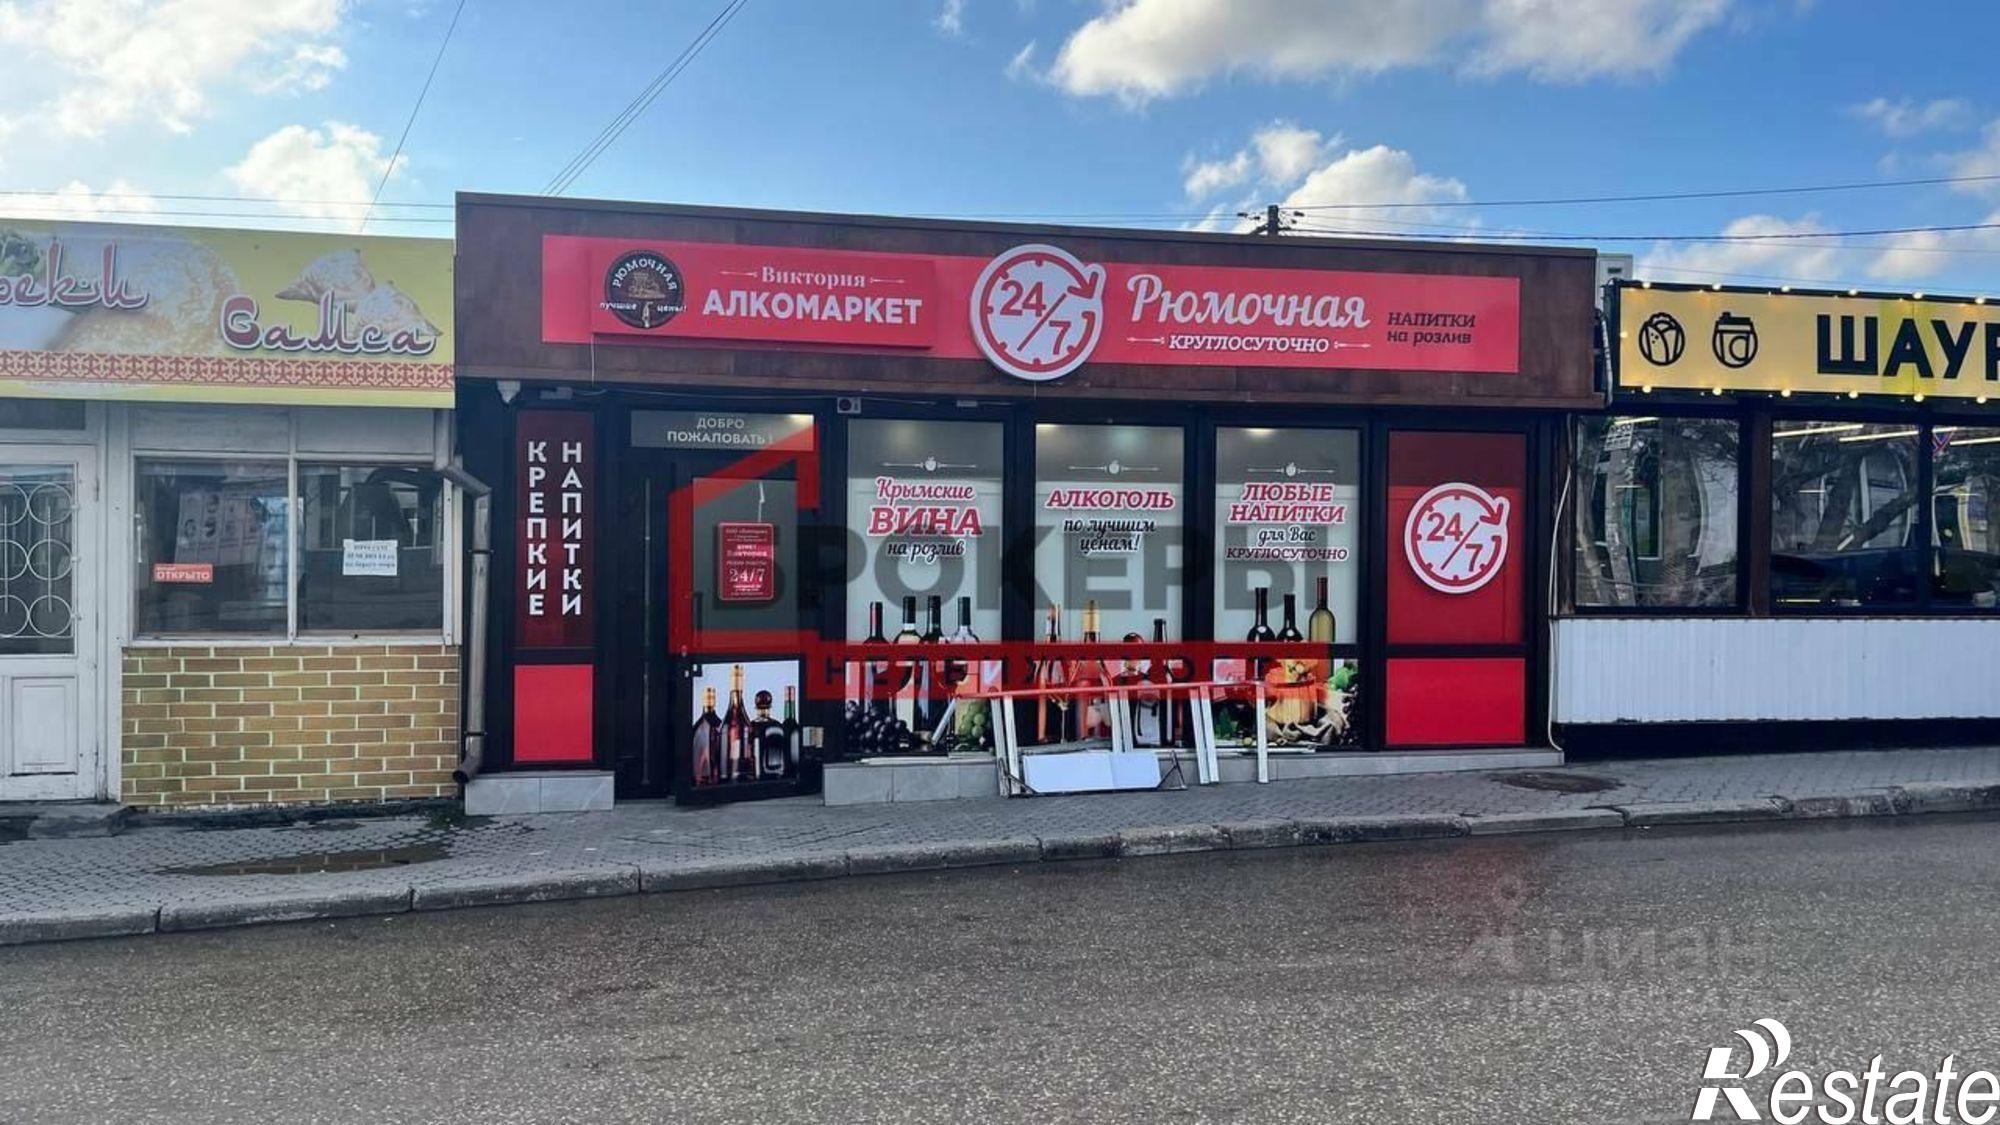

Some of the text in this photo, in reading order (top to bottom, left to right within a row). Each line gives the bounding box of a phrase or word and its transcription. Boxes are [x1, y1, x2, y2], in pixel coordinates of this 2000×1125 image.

[611, 258, 678, 291] РЮМОЧНАЯ
[761, 264, 866, 288] Виктория
[702, 288, 923, 325] АЛКОМАРКЕТ
[1126, 273, 1371, 330] Рюмочная
[221, 288, 437, 354] Самса
[1000, 280, 1073, 355] 24/7
[1387, 310, 1477, 329] НАПИТКИ
[1168, 334, 1329, 353] КРУГЛОСУТОЧНО
[1387, 330, 1472, 348] на розлив
[696, 417, 745, 430] ДОБРО
[666, 429, 766, 445] ПОЖАЛОВАТЬ
[876, 478, 974, 504] Крымские
[1047, 490, 1175, 509] АЛКОГОЛЬ
[1242, 484, 1334, 502] ЛЮБЫЕ
[867, 506, 983, 536] ВИНА
[1229, 503, 1347, 523] НАПИТКИ
[526, 441, 547, 616] КРЕПКИЕ
[561, 441, 582, 616] НАПИТКИ
[1064, 518, 1156, 540] по лучшим
[1257, 526, 1317, 546] для Вас
[886, 540, 965, 562] на розлив
[1079, 534, 1141, 554] ценам!
[1426, 511, 1483, 572] 24/7
[1225, 547, 1348, 561] КРУГЛОСУТОЧНО
[157, 570, 209, 580] ОТКРЫТО
[729, 567, 765, 582] 24/7
